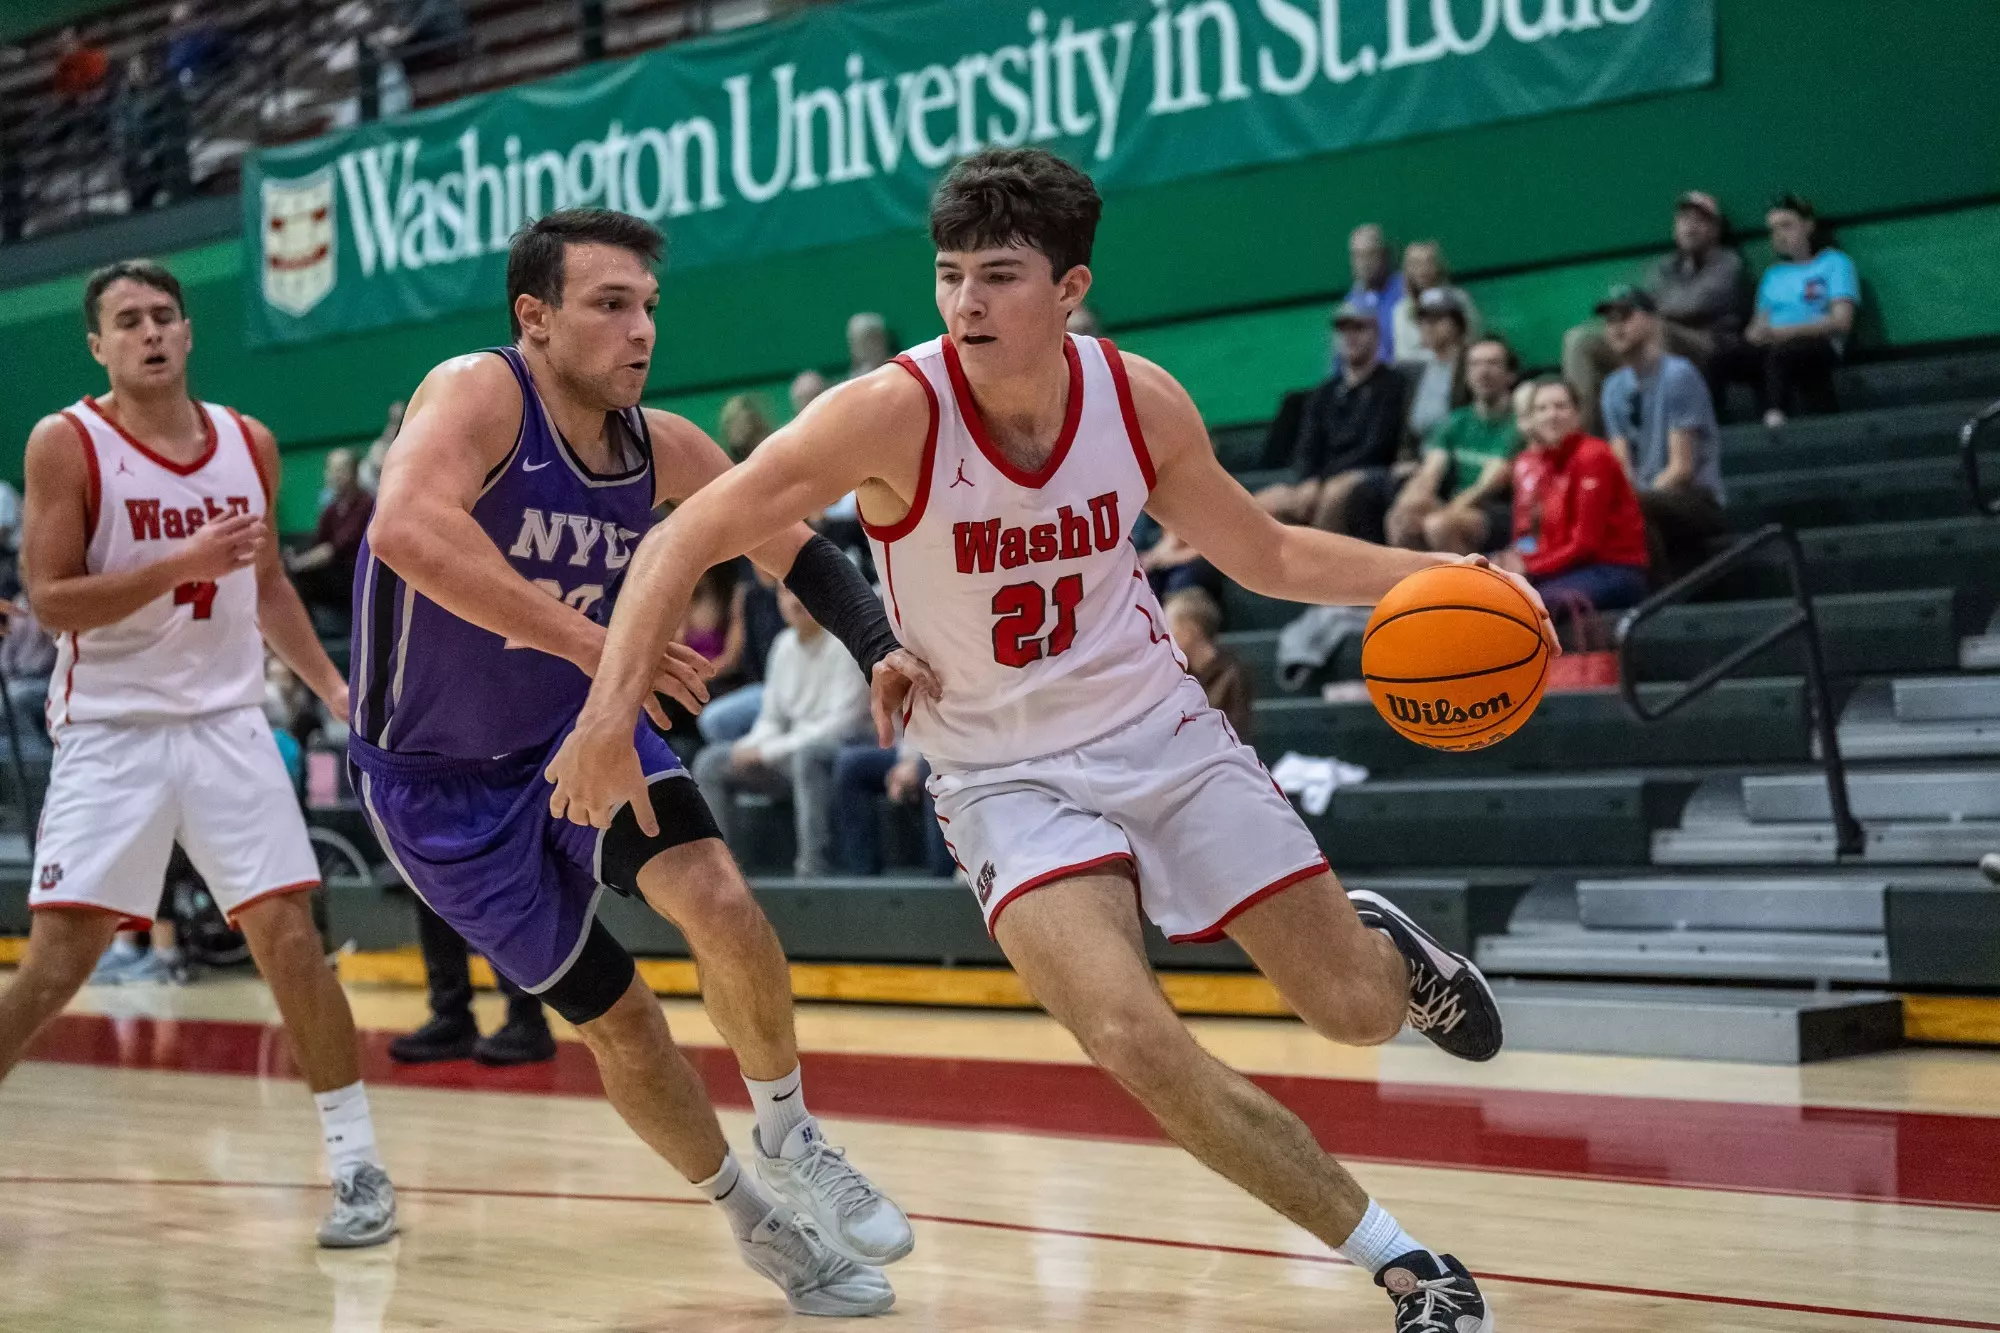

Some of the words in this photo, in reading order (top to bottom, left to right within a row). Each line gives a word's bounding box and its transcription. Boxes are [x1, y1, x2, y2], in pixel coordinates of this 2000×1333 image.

[338, 116, 728, 279] Washington
[723, 9, 1136, 203] University
[1145, 0, 1252, 116] in
[952, 490, 1120, 575] WashU
[991, 572, 1084, 669] 21
[1384, 691, 1513, 726] Wilson
